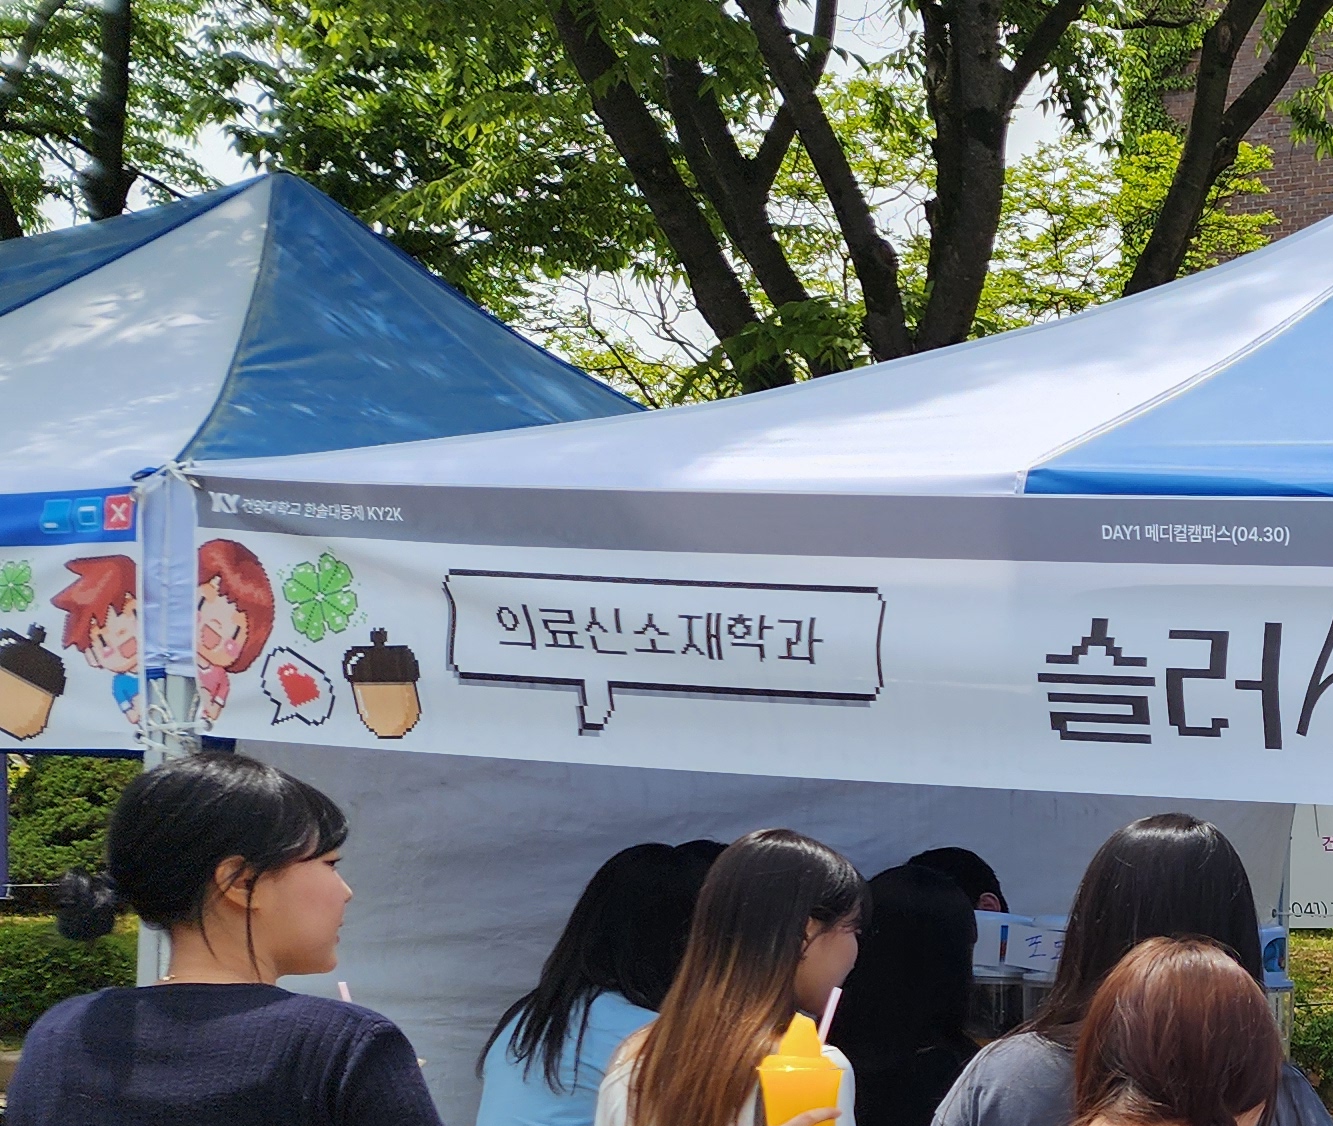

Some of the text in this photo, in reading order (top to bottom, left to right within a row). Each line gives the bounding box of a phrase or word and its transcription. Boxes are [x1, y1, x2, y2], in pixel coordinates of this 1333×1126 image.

[242, 499, 301, 516] 건양대학교
[304, 503, 364, 521] 한솔대동제
[367, 506, 404, 521] KY2K
[1101, 523, 1291, 546] DAY1 메디컬캠퍼스(04.30)
[497, 604, 824, 665] 의료신소재학과
